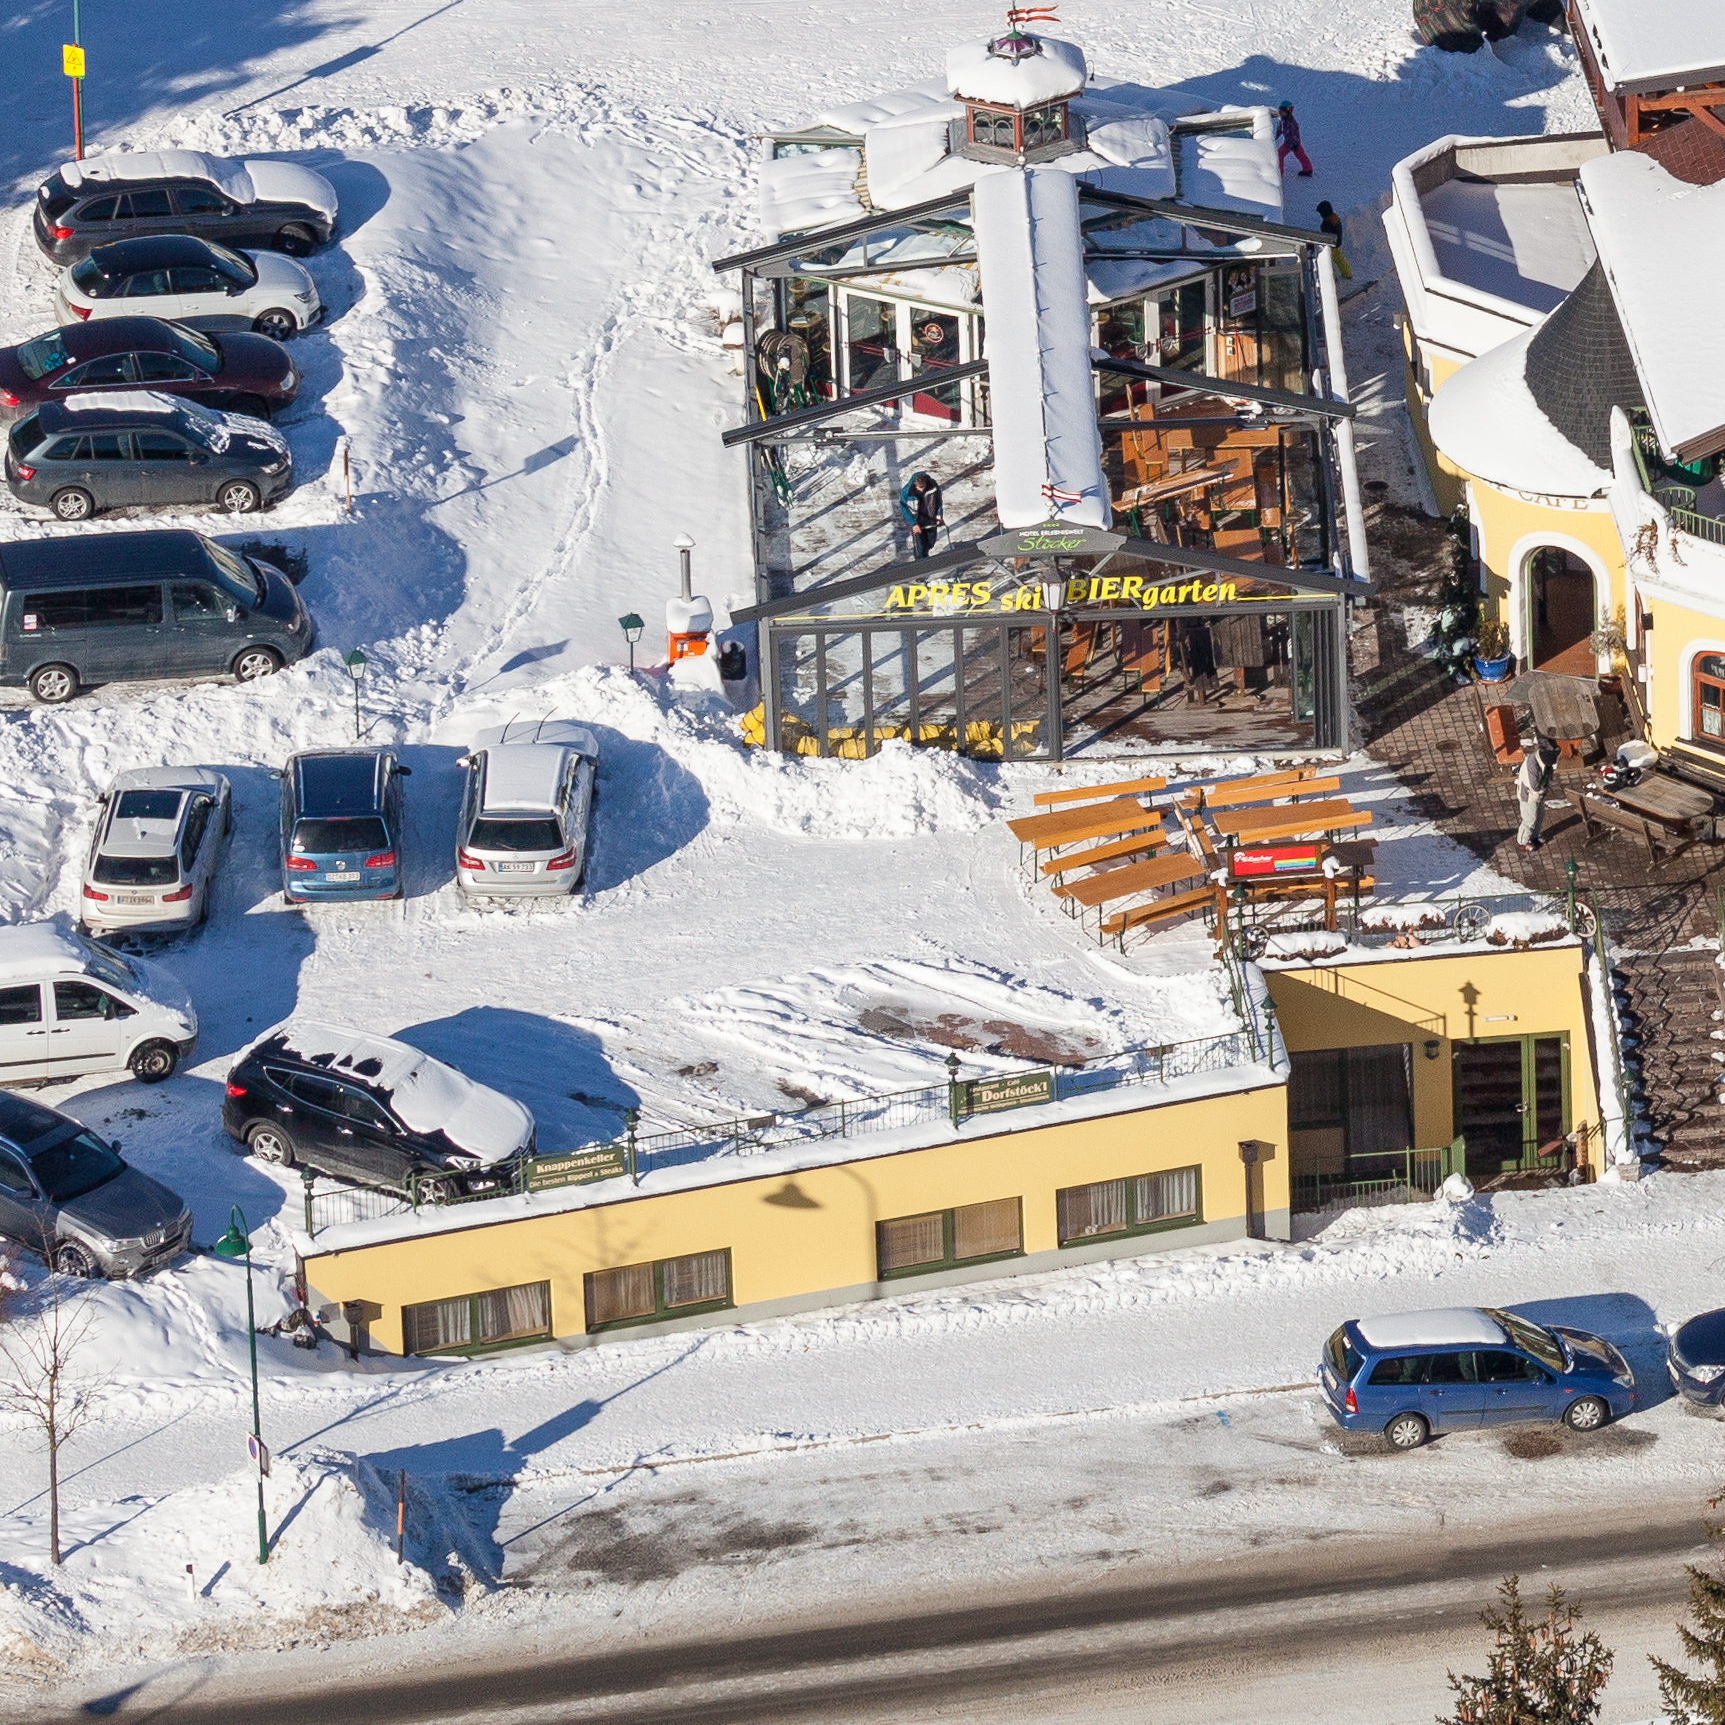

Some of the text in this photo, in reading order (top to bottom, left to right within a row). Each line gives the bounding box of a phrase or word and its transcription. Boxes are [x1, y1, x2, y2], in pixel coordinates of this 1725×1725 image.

[1017, 535, 1087, 551] Stocker
[884, 581, 992, 609] APRES
[1001, 585, 1042, 611] ski
[536, 1153, 616, 1174] Knappenkeller
